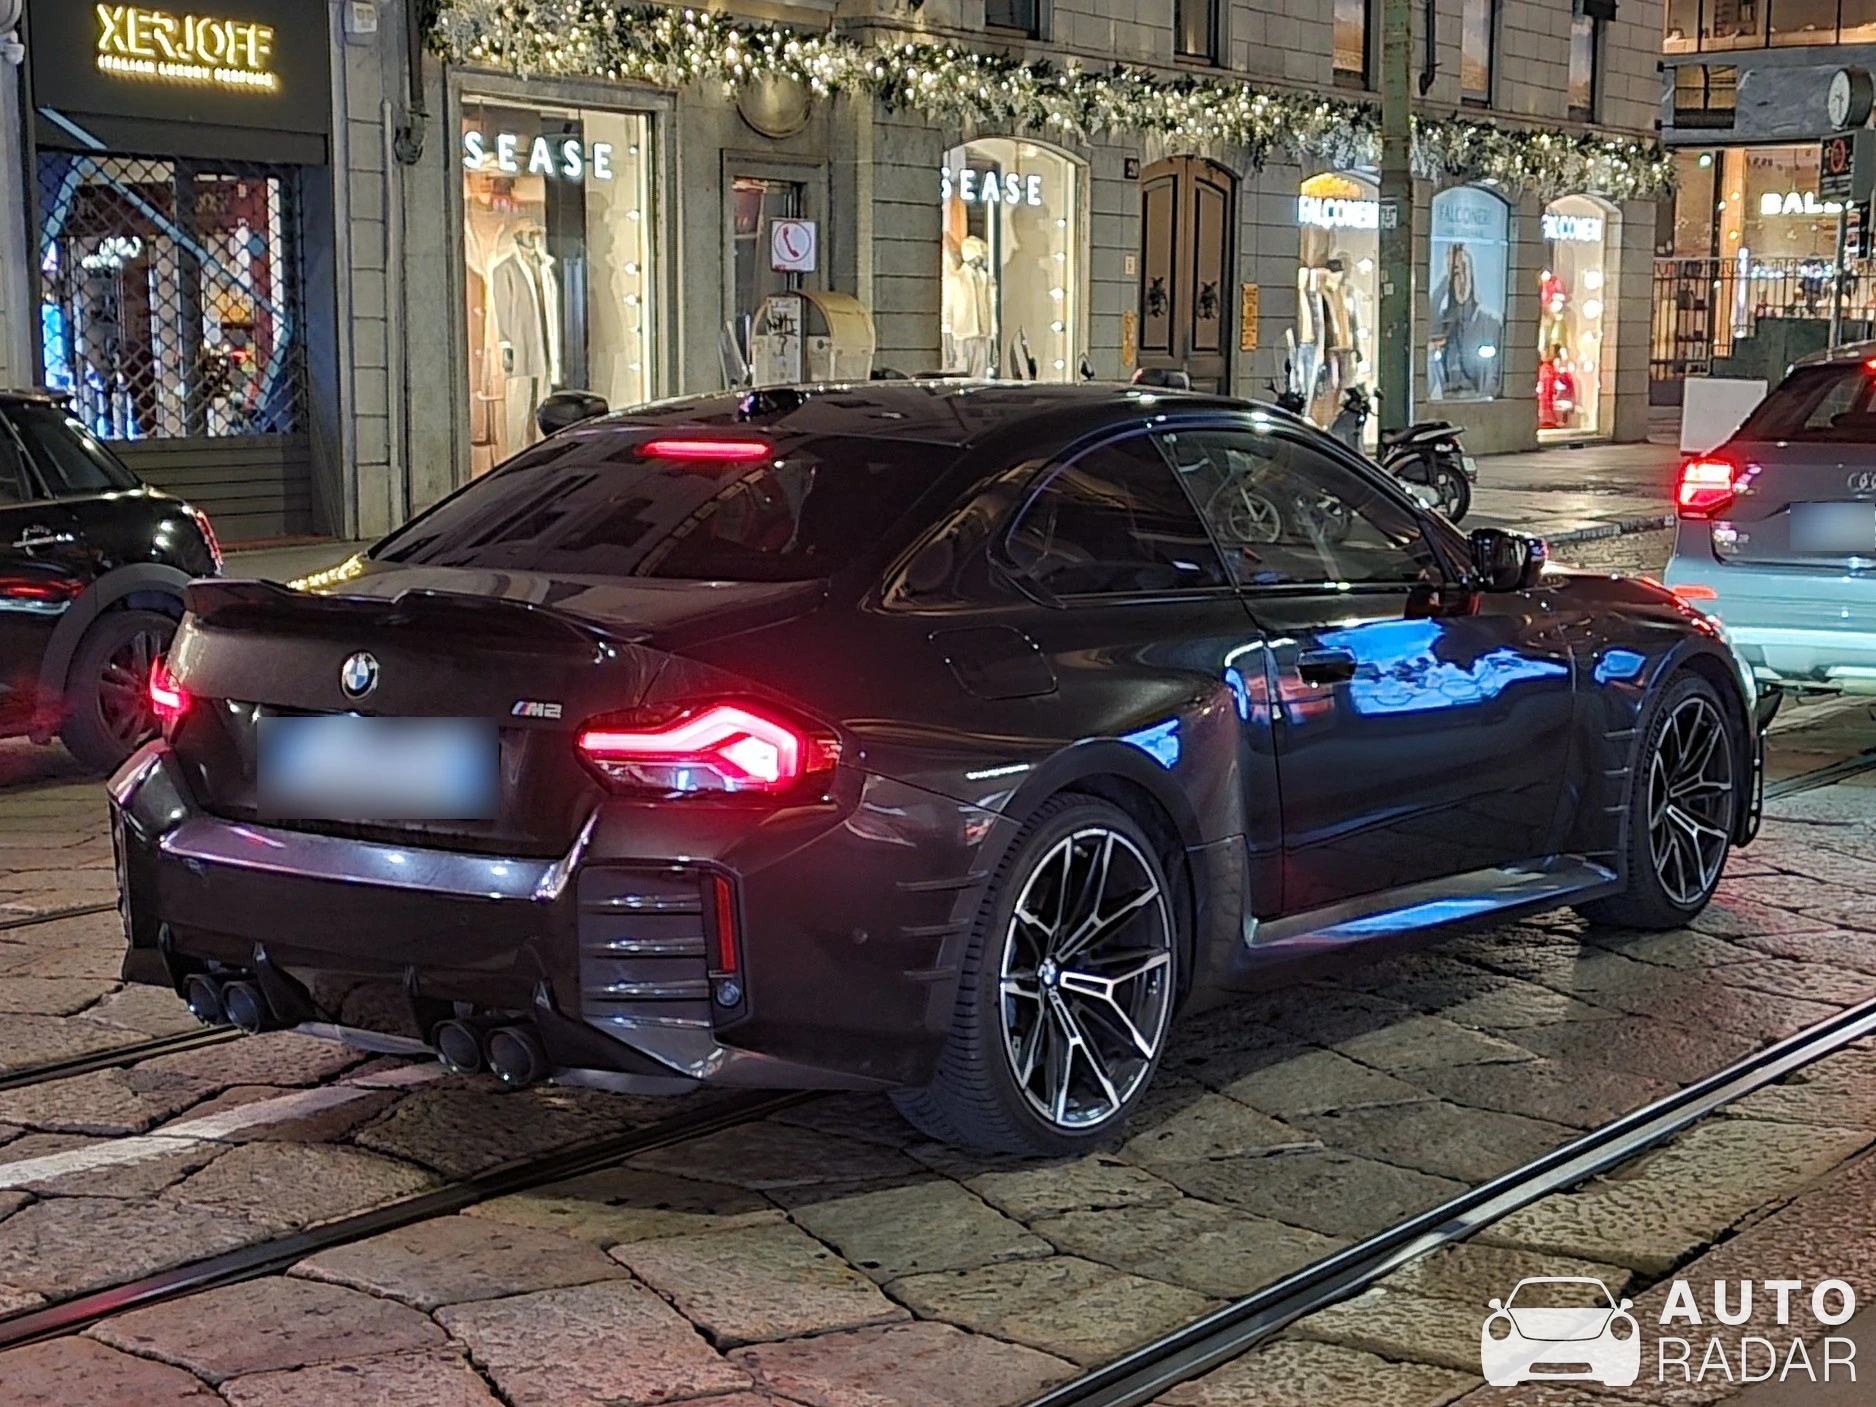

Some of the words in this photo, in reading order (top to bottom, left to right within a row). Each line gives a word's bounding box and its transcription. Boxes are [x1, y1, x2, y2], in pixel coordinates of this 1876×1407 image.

[96, 3, 274, 67] XERJOFF
[98, 54, 155, 74] ITALIAN
[463, 130, 613, 179] SEASE
[511, 700, 563, 719] M2
